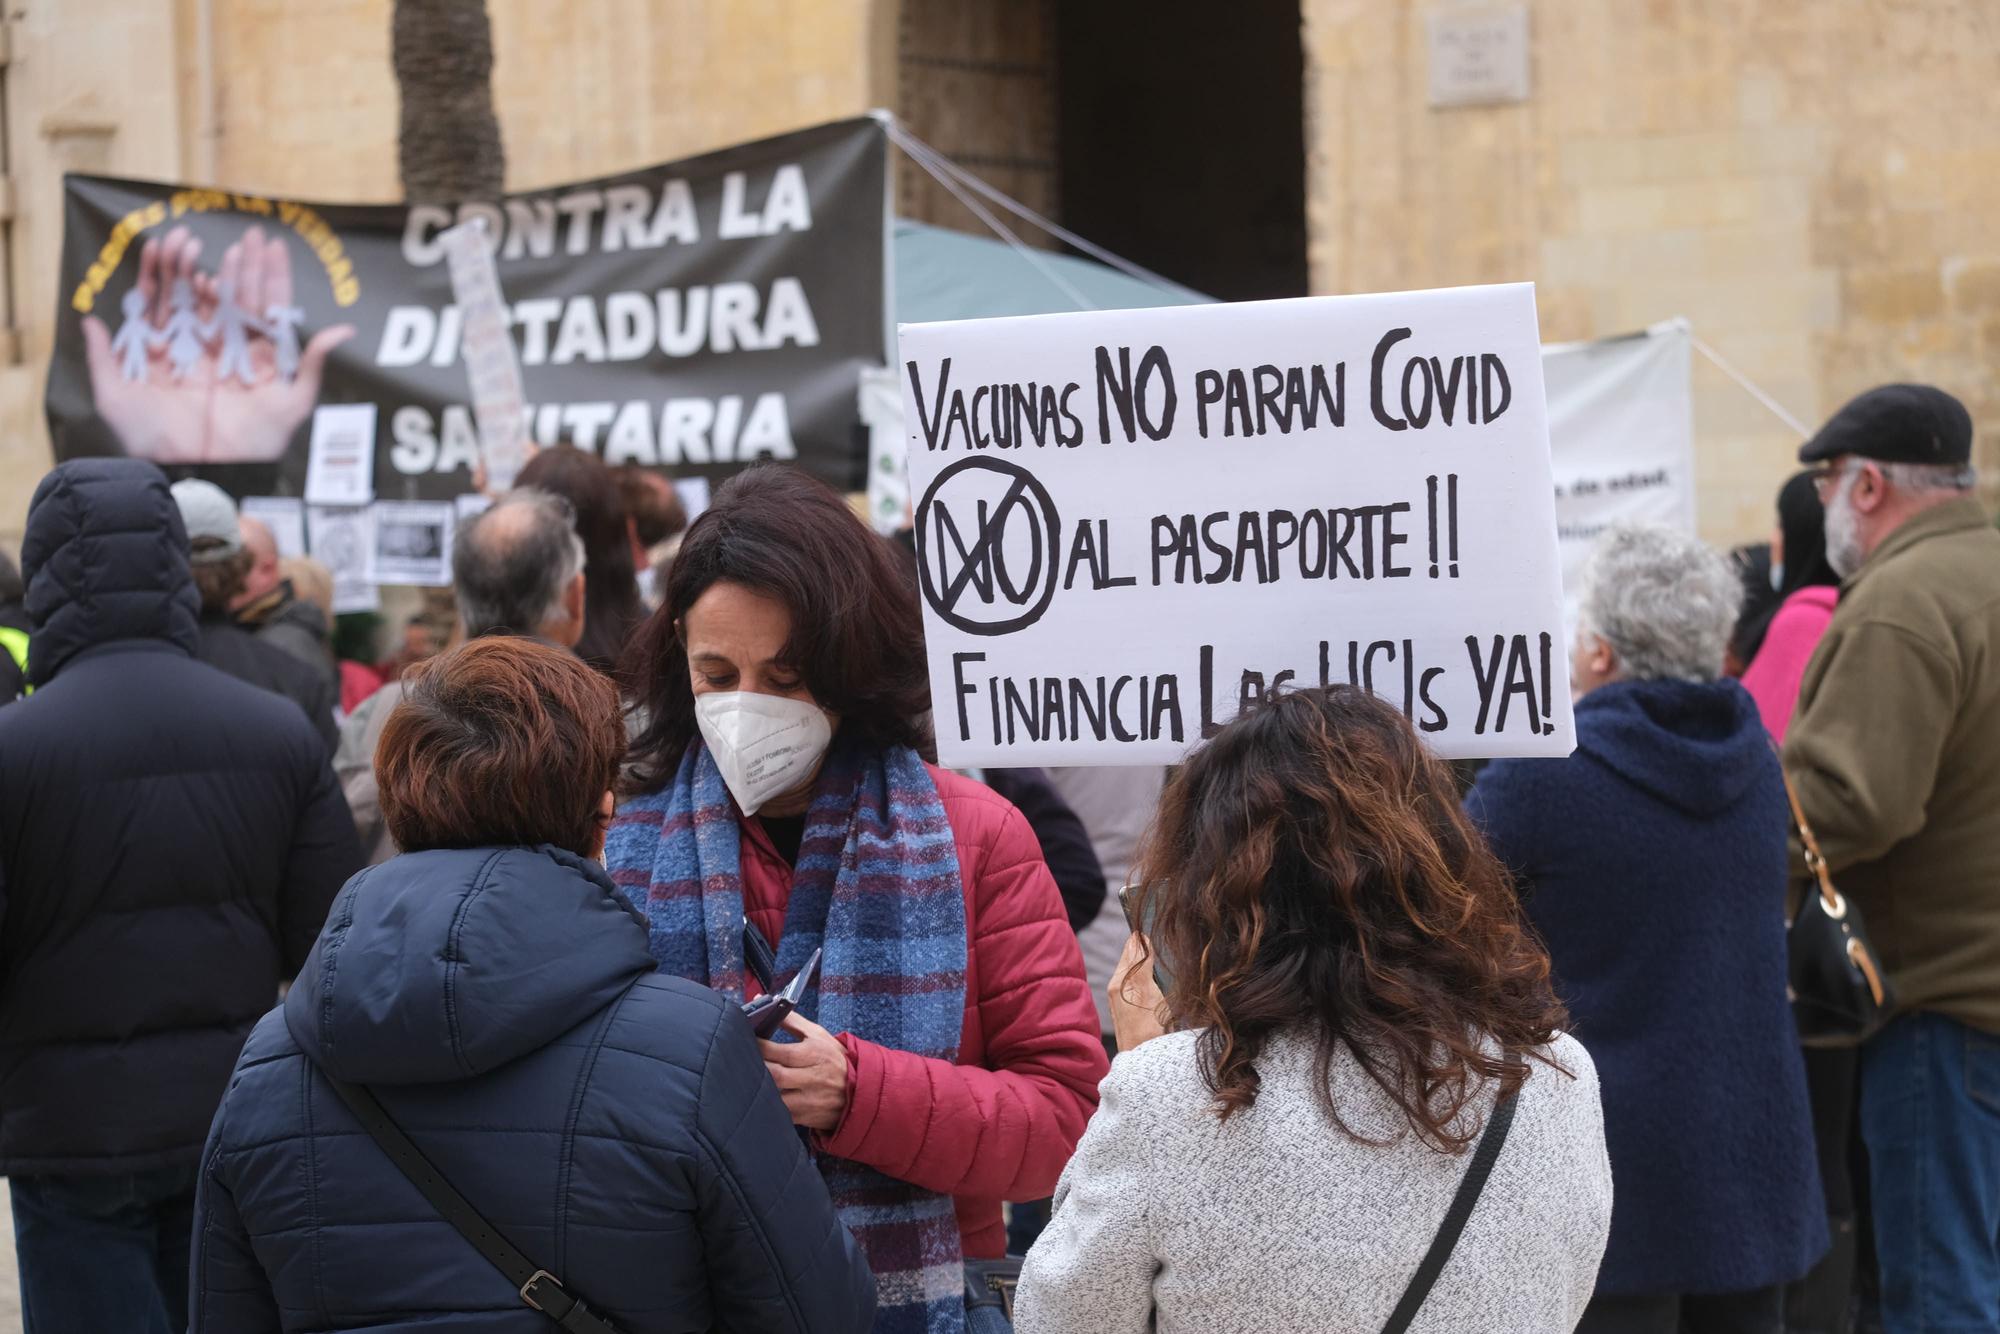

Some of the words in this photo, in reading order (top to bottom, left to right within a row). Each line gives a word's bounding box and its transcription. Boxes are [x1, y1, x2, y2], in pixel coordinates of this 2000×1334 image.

[718, 163, 812, 240] LA
[375, 277, 820, 367] DITADURA
[391, 391, 797, 474] SAITARIA
[1096, 346, 1177, 444] NO
[1196, 362, 1345, 438] PARAN
[933, 497, 1043, 606] NO
[1064, 519, 1136, 590] AL
[1465, 632, 1556, 737] YA!
